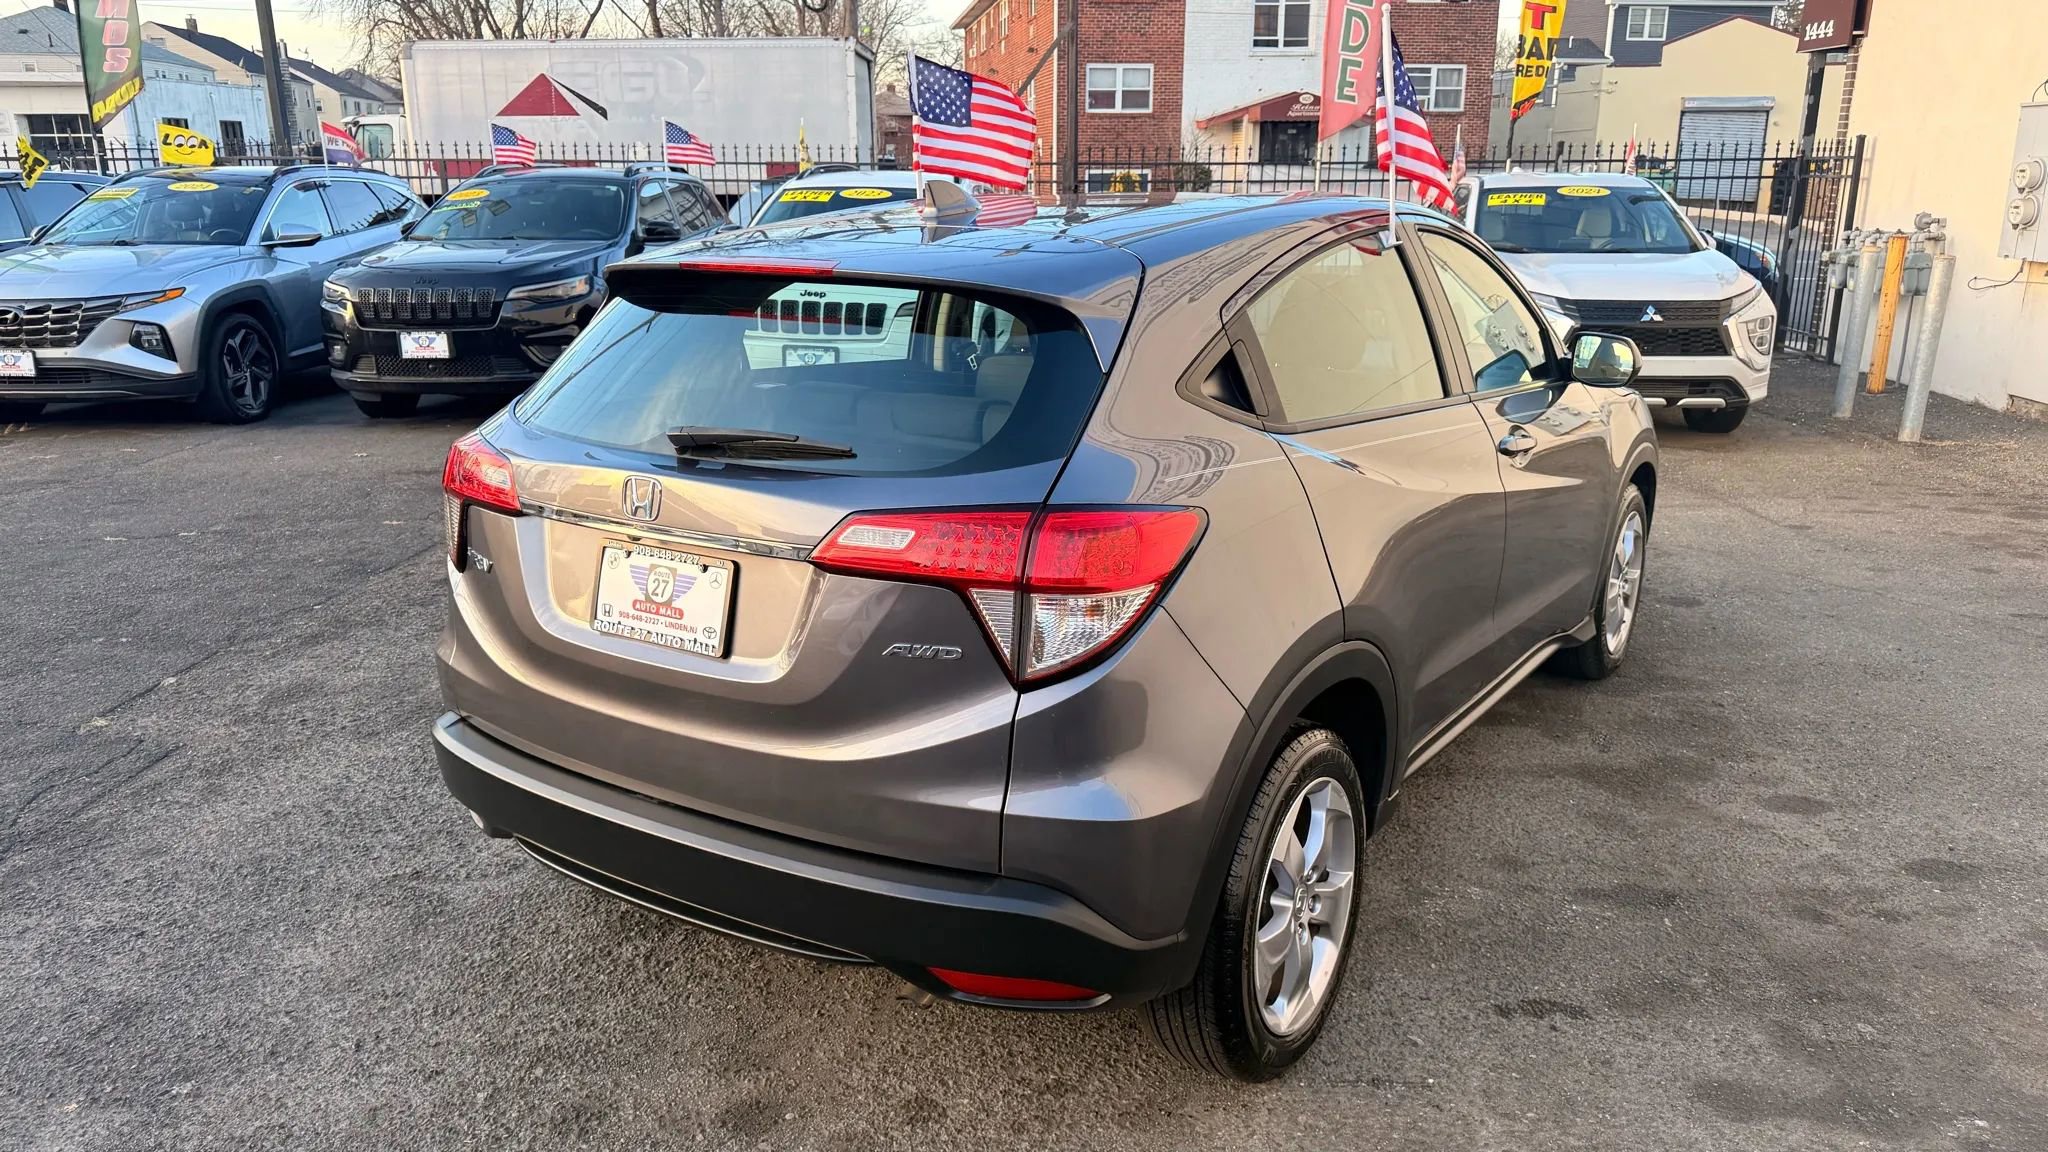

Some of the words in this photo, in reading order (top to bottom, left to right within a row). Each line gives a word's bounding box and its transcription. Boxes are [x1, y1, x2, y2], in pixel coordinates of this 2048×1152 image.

[1804, 19, 1834, 41] 1444
[1334, 0, 1375, 105] DE
[1567, 187, 1601, 195] 2024
[799, 289, 827, 299] Jeep
[633, 545, 701, 567] 908-648-2727
[654, 571, 670, 579] ROUTE
[651, 577, 670, 599] 27
[618, 610, 660, 625] 908-648-2727
[635, 601, 657, 613] AUTO
[659, 605, 681, 619] MALL
[594, 620, 631, 636] ROUTE
[634, 629, 648, 639] 27
[651, 632, 681, 648] AUTO
[684, 639, 716, 656] MALL
[881, 643, 963, 660] AWD
